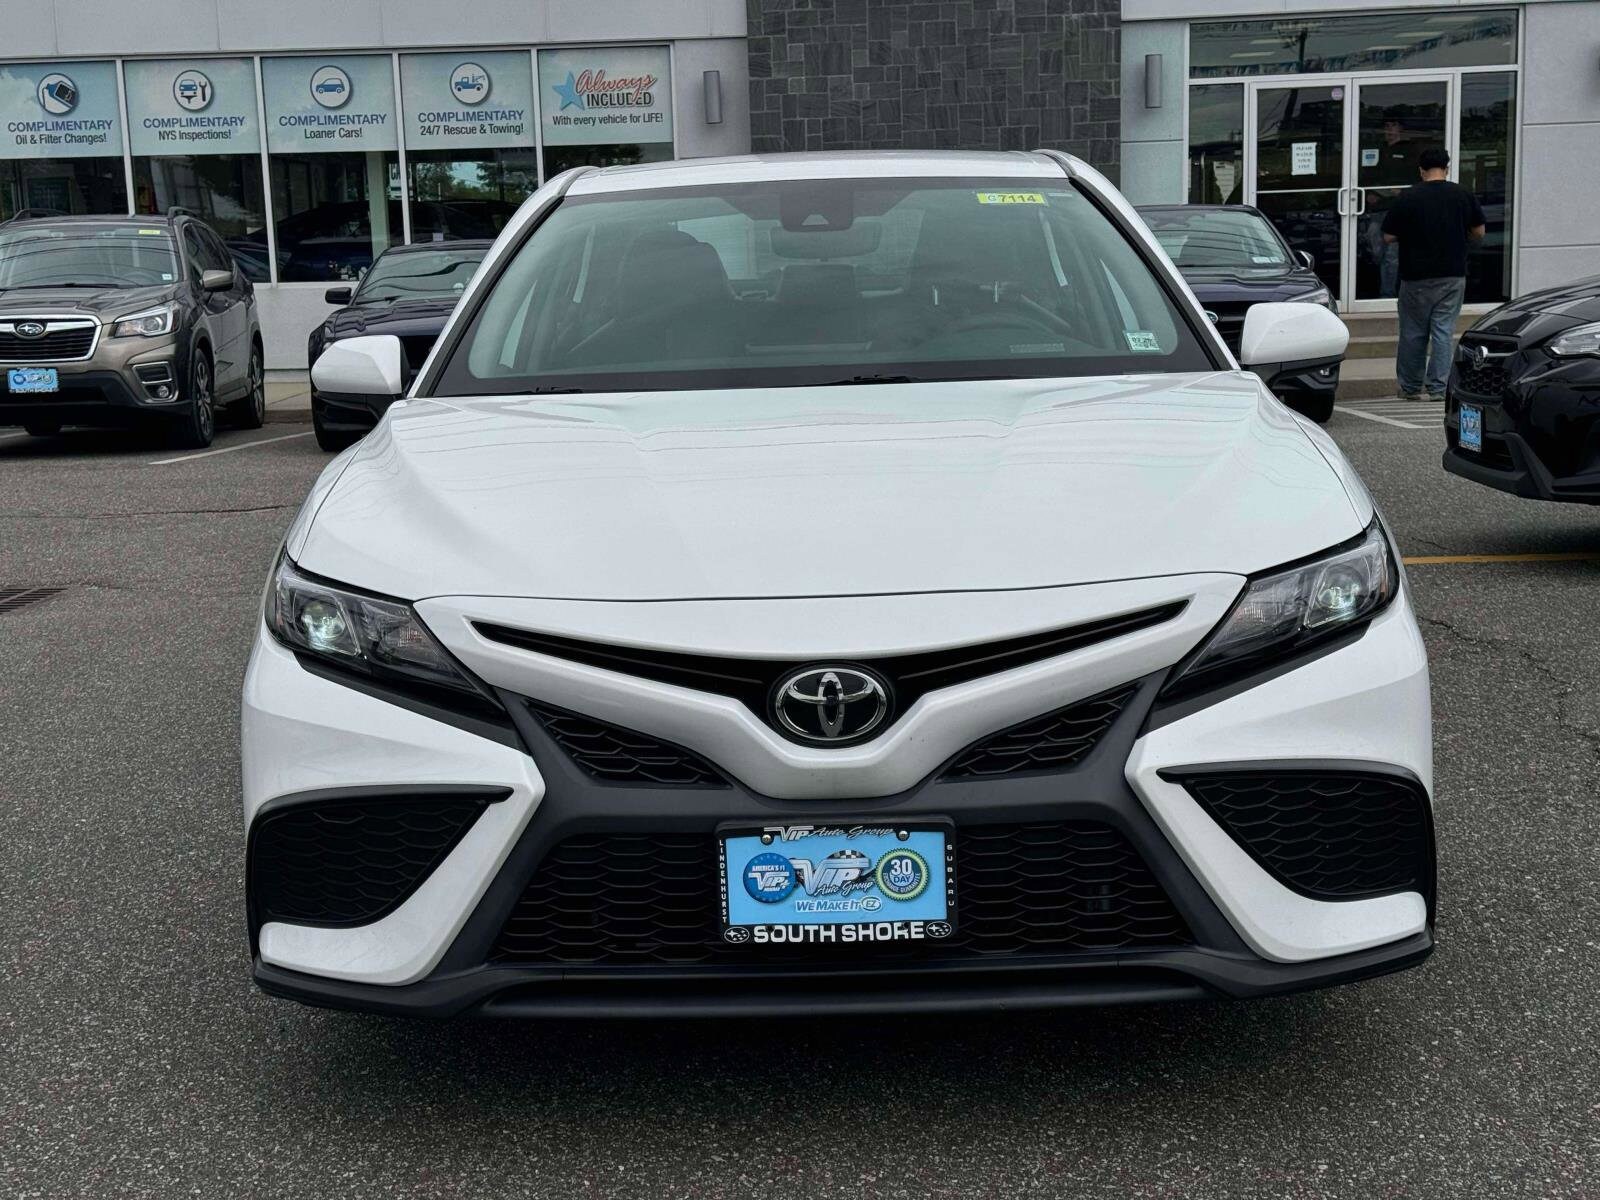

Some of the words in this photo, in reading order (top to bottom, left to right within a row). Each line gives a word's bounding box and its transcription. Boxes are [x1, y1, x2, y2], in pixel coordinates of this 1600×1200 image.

[575, 69, 657, 102] Always
[586, 92, 653, 107] INCLUDED
[143, 116, 245, 129] COMPLIMENTARY
[279, 114, 387, 127] COMPLIMENTARY
[417, 110, 524, 123] COMPLIMENTARY
[552, 116, 572, 125] With
[573, 115, 598, 126] every
[599, 114, 628, 124] vehicle
[629, 113, 641, 123] for
[642, 112, 664, 123] LIFE!
[7, 120, 114, 133] COMPLIMENTARY
[304, 128, 336, 139] Loaner
[338, 127, 362, 138] Cars!
[420, 125, 441, 136] 24/7
[443, 124, 478, 135] Rescue
[479, 124, 487, 134] &
[488, 123, 524, 135] Towing!
[15, 134, 28, 145] Oil
[30, 134, 37, 144] &
[39, 133, 62, 144] Filter
[64, 133, 107, 145] Changes!
[158, 130, 177, 141] NYS
[178, 129, 232, 141] Inspections!
[764, 826, 814, 842] VIP
[808, 827, 844, 836] Auto
[847, 826, 893, 838] Group
[890, 859, 912, 875] 30
[719, 840, 727, 923] LINDENHURST
[790, 858, 869, 895] VIP
[946, 844, 954, 906] SUBARU
[814, 883, 840, 896] Auto
[841, 880, 874, 896] Group
[754, 924, 836, 943] SOUTH
[841, 922, 925, 943] SHORE
